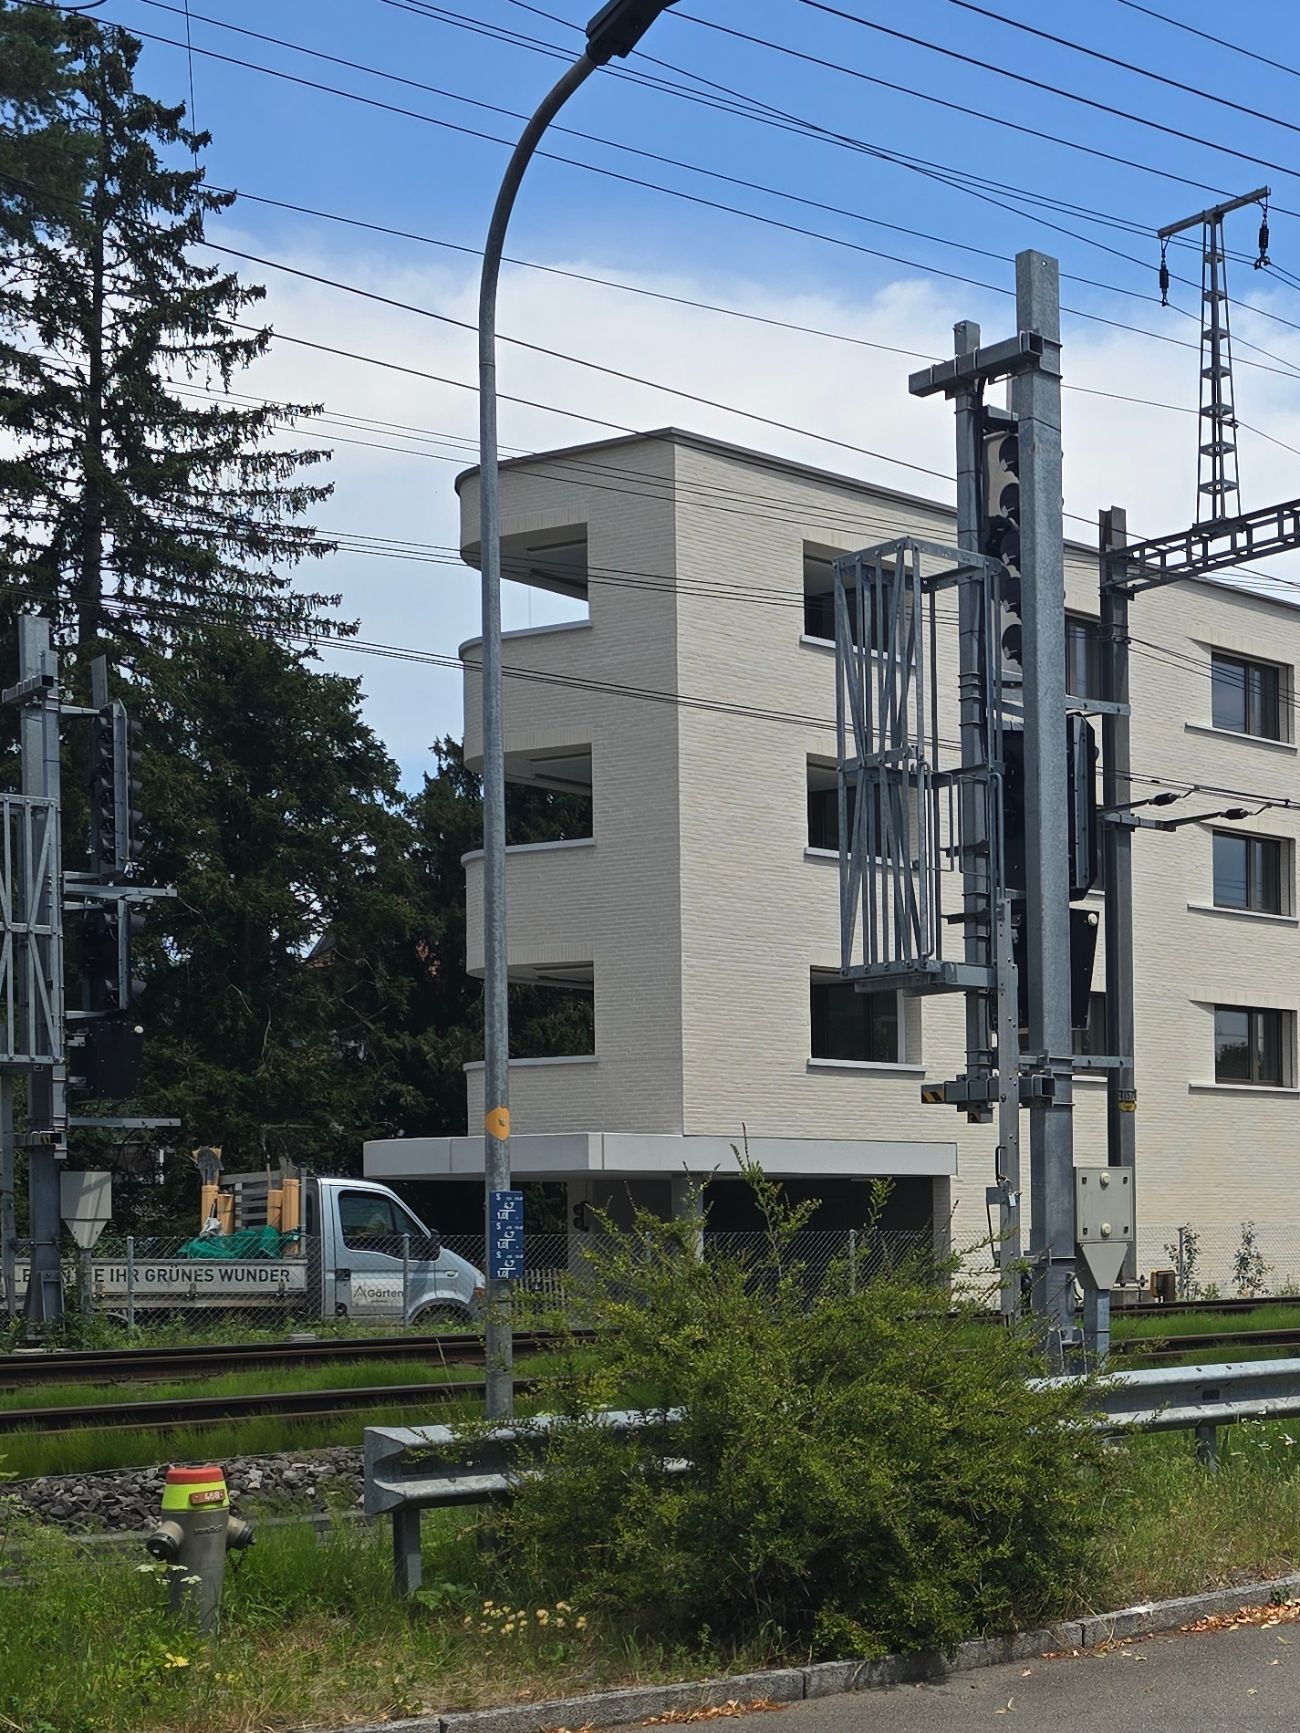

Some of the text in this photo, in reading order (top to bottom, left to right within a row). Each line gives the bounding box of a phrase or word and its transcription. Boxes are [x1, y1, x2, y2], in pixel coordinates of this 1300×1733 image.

[110, 1268, 140, 1283] IHR
[145, 1265, 214, 1283] GRÜNES
[218, 1268, 290, 1283] WUNDER
